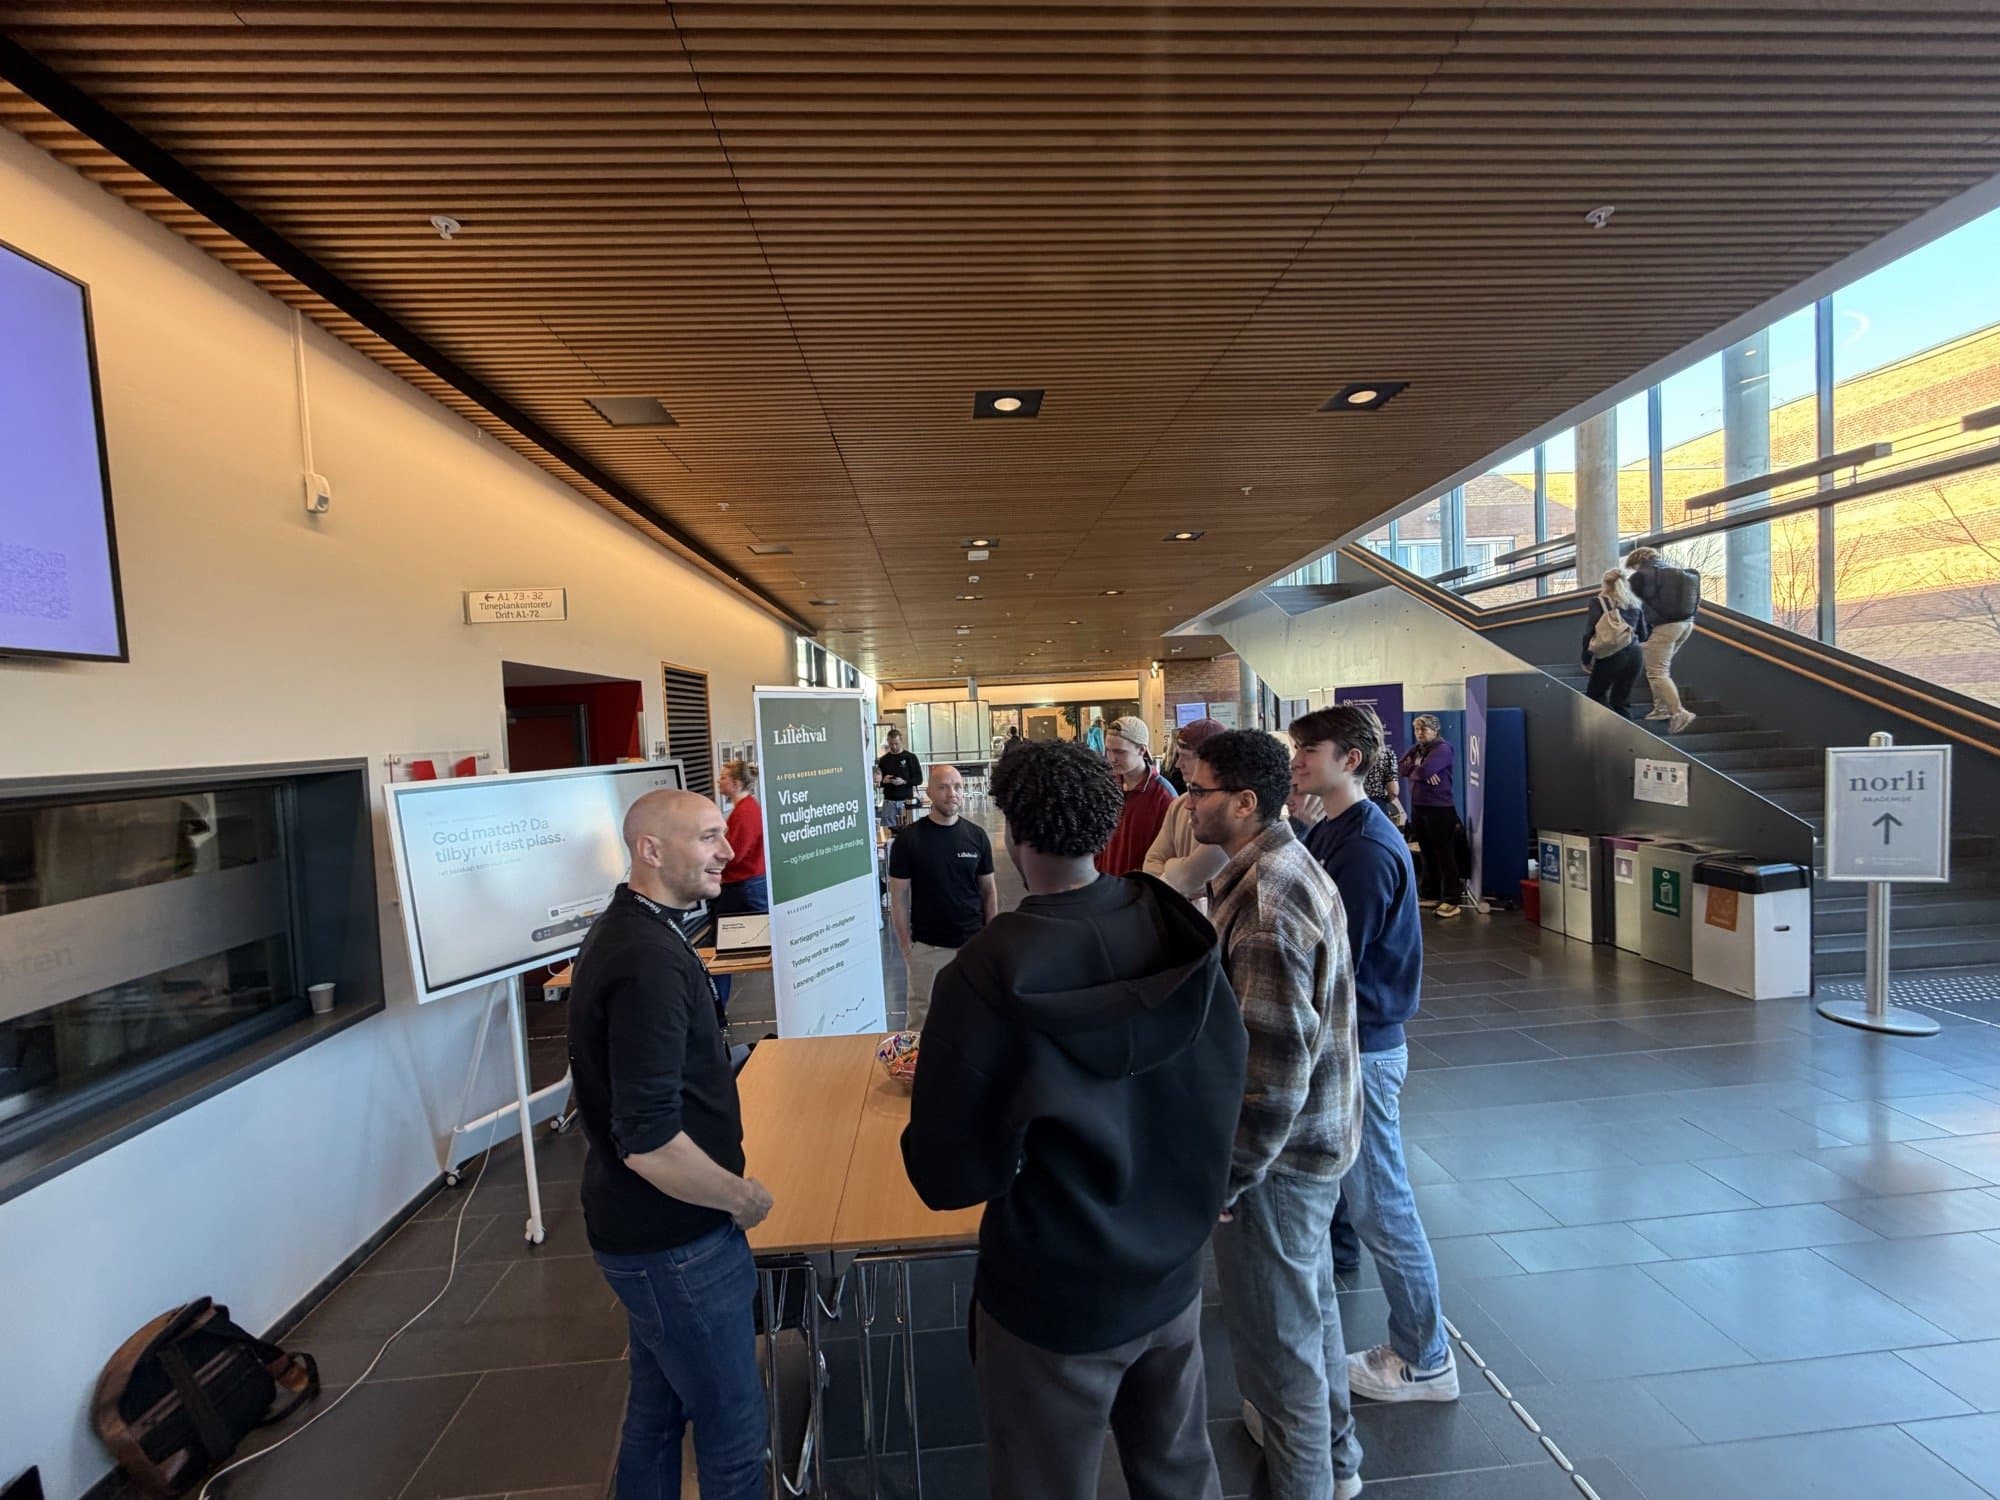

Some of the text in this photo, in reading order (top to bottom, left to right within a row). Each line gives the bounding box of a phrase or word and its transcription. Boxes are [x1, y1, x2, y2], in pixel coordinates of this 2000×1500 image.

[513, 592, 525, 600] 73
[532, 592, 544, 600] 32
[495, 611, 515, 619] Drift
[784, 772, 796, 780] FOR
[1849, 769, 1926, 791] norli
[778, 789, 808, 806] Vi ser
[780, 800, 859, 825] mulighetene og
[433, 818, 549, 845] God match? Da
[781, 824, 822, 843] verdien
[823, 816, 846, 834] med
[435, 846, 476, 862] tilbyr
[496, 837, 525, 853] fast
[526, 833, 566, 851] plass.
